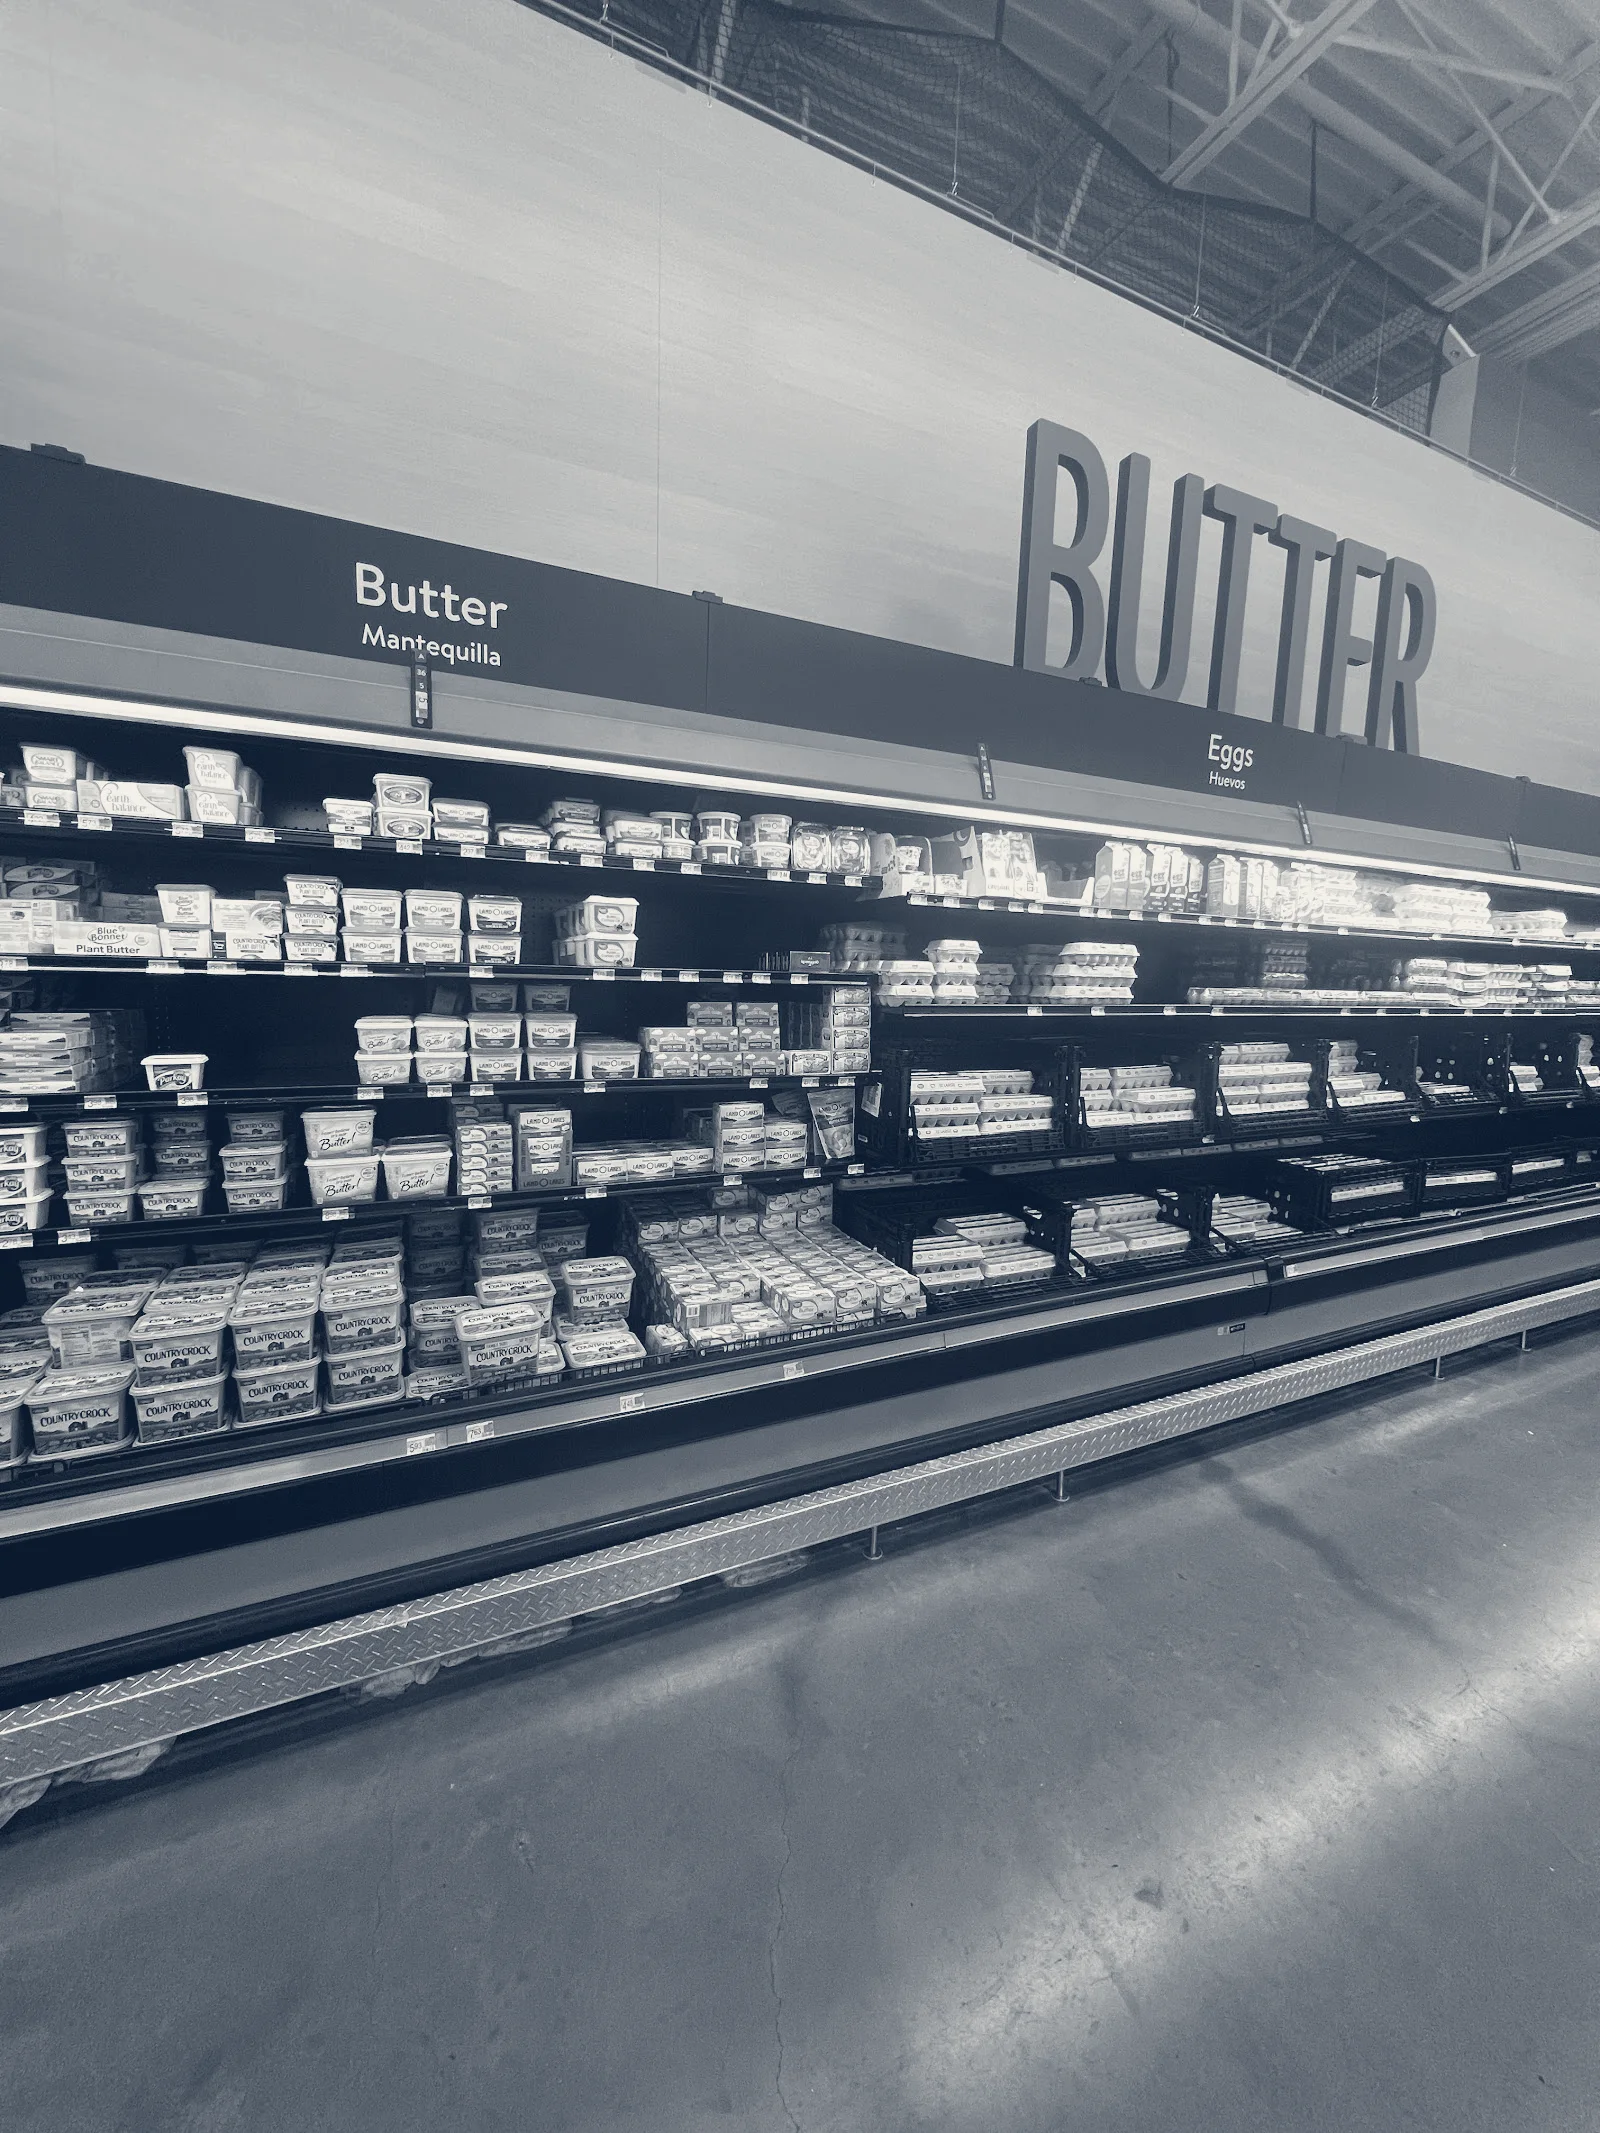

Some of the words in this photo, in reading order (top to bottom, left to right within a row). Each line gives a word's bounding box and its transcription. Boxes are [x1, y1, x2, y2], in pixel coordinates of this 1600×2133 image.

[356, 562, 508, 629] Butter
[1013, 418, 1436, 757] BUTTER
[362, 623, 501, 667] Mantequilla
[1208, 733, 1254, 772] Eggs
[1209, 772, 1246, 790] Huevos
[91, 934, 125, 942] Bonnet
[97, 927, 118, 935] Blue
[76, 945, 104, 953] Plant
[106, 946, 140, 954] Butter
[159, 1072, 187, 1086] Parkay
[73, 1135, 99, 1143] COUNTRY
[319, 1132, 356, 1151] Butter!
[73, 1169, 98, 1177] COUNTRY
[98, 1168, 120, 1176] CROCK
[324, 1178, 361, 1197] Butter!
[400, 1174, 434, 1192] Butter!
[75, 1203, 100, 1211] COUNTRY
[580, 1293, 605, 1304] COUNTRY
[606, 1292, 626, 1300] CROCK
[336, 1320, 366, 1332] COUNTRY
[367, 1316, 392, 1325] CROCK
[243, 1333, 278, 1346] COUNTRY
[278, 1330, 304, 1340] CROCK
[144, 1349, 182, 1363] COUNTRY
[182, 1345, 212, 1356] CROCK
[476, 1350, 507, 1363] COUNTRY
[507, 1345, 533, 1355] CROCK
[338, 1368, 370, 1381] COUNTRY
[370, 1364, 394, 1374] CROCK
[248, 1384, 282, 1398] COUNTRY
[282, 1380, 309, 1390] CROCK
[146, 1403, 183, 1417] COUNTRY
[183, 1398, 213, 1410] CROCK
[40, 1413, 79, 1427] COUNTRY
[80, 1408, 112, 1421] CROCK
